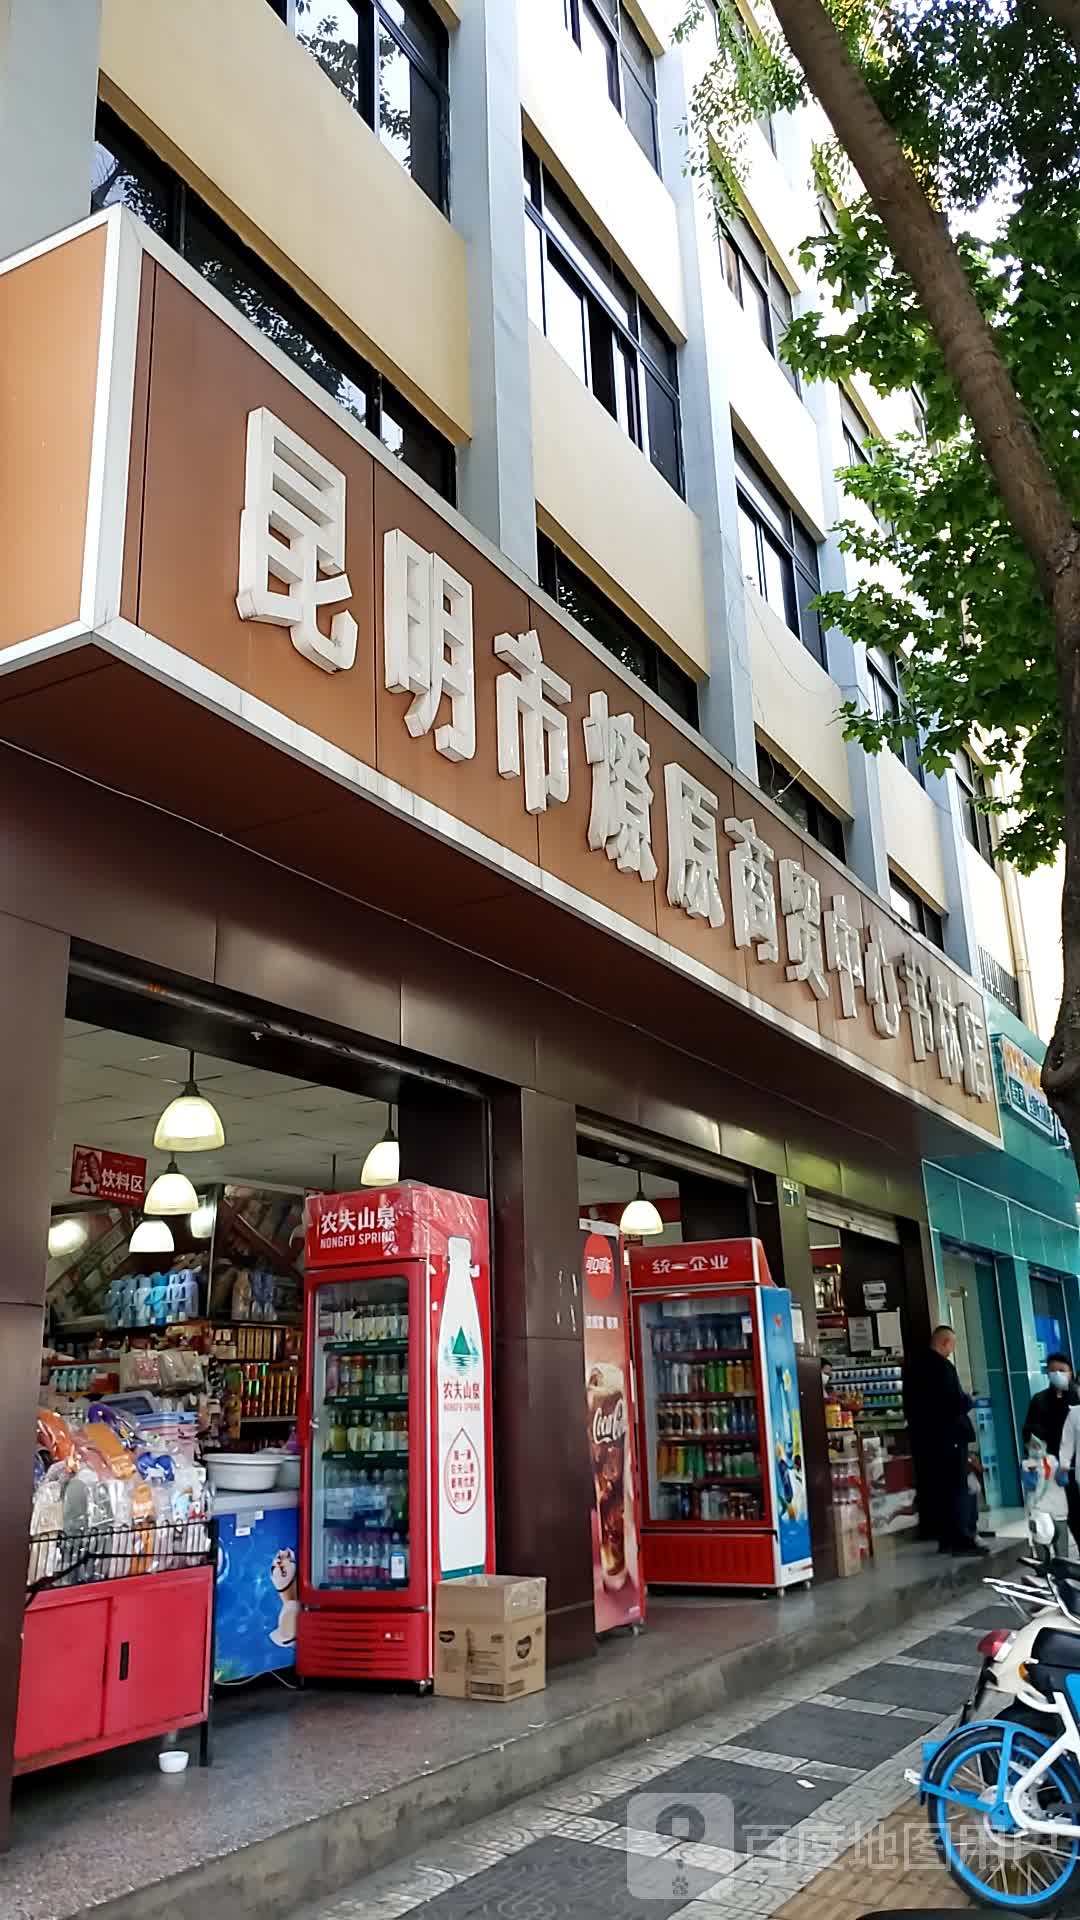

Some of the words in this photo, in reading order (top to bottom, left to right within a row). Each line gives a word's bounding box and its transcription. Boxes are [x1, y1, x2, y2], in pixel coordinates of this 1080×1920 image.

[101, 1168, 144, 1193] 饮料区
[320, 1206, 396, 1235] 农夫山泉
[320, 1234, 355, 1249] NONGFU
[358, 1231, 395, 1245] SPRING
[652, 1255, 729, 1274] 统一企业
[443, 1380, 480, 1400] 农夫山泉
